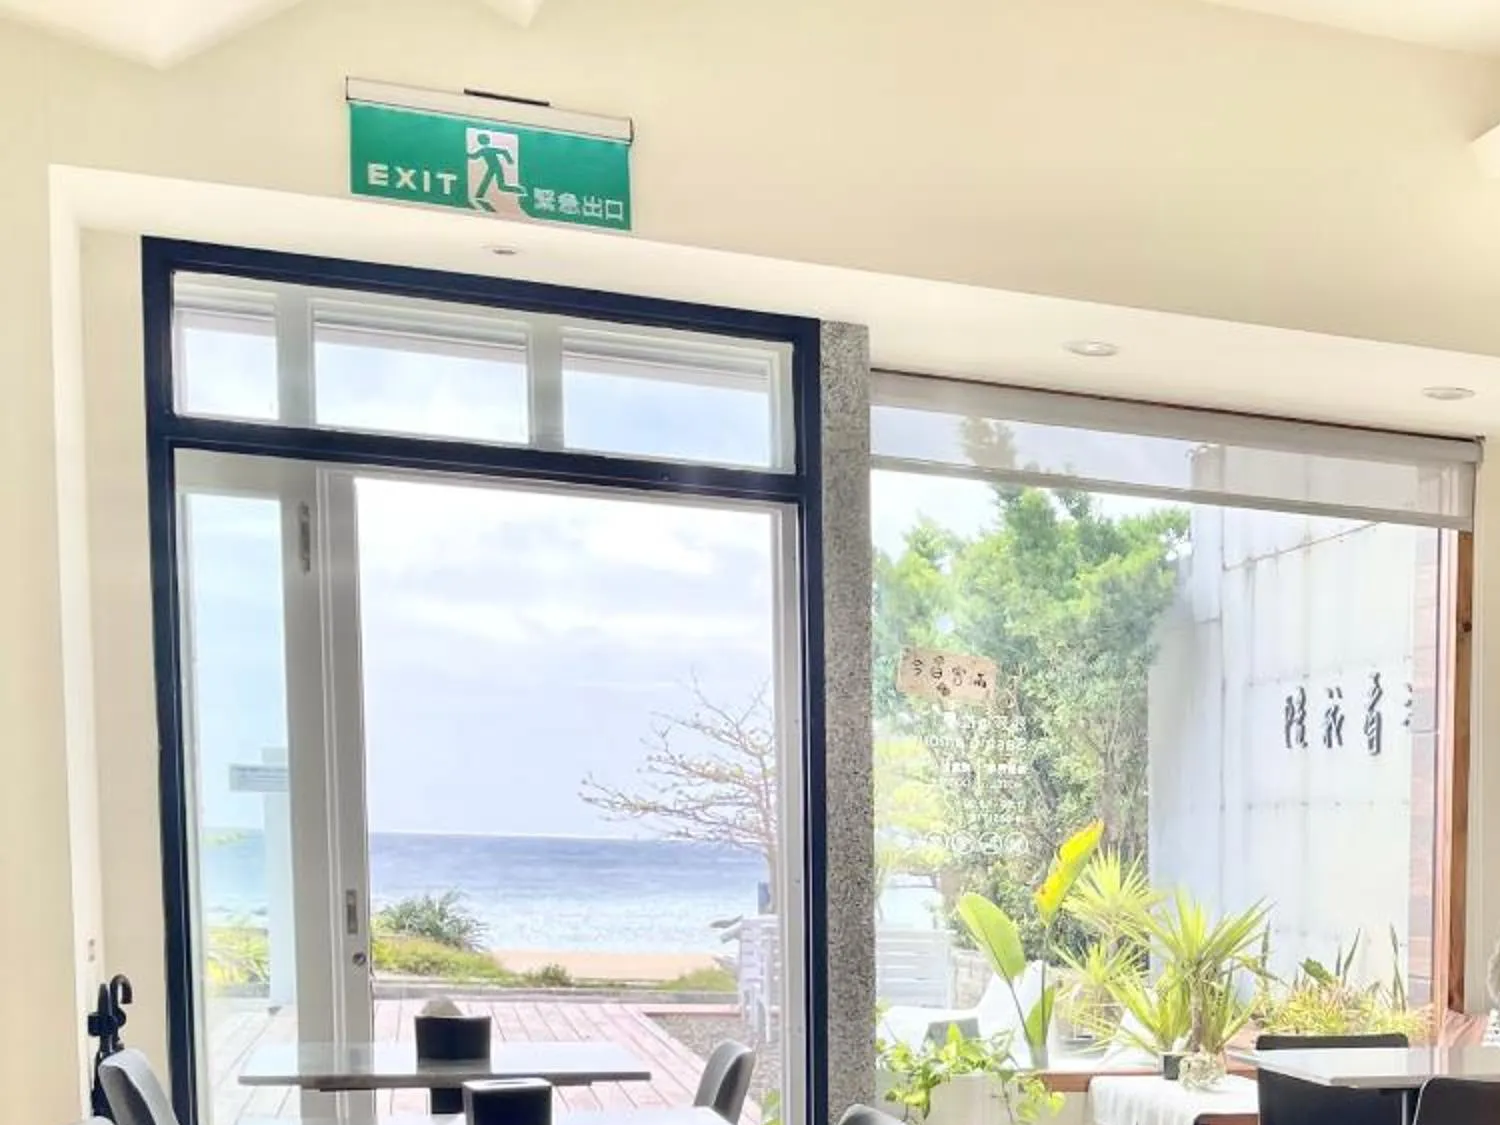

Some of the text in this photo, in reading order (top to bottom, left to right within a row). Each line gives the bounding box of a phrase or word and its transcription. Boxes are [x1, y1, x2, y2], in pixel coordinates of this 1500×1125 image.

[367, 162, 458, 195] EXIT
[533, 187, 624, 221] 緊急出口
